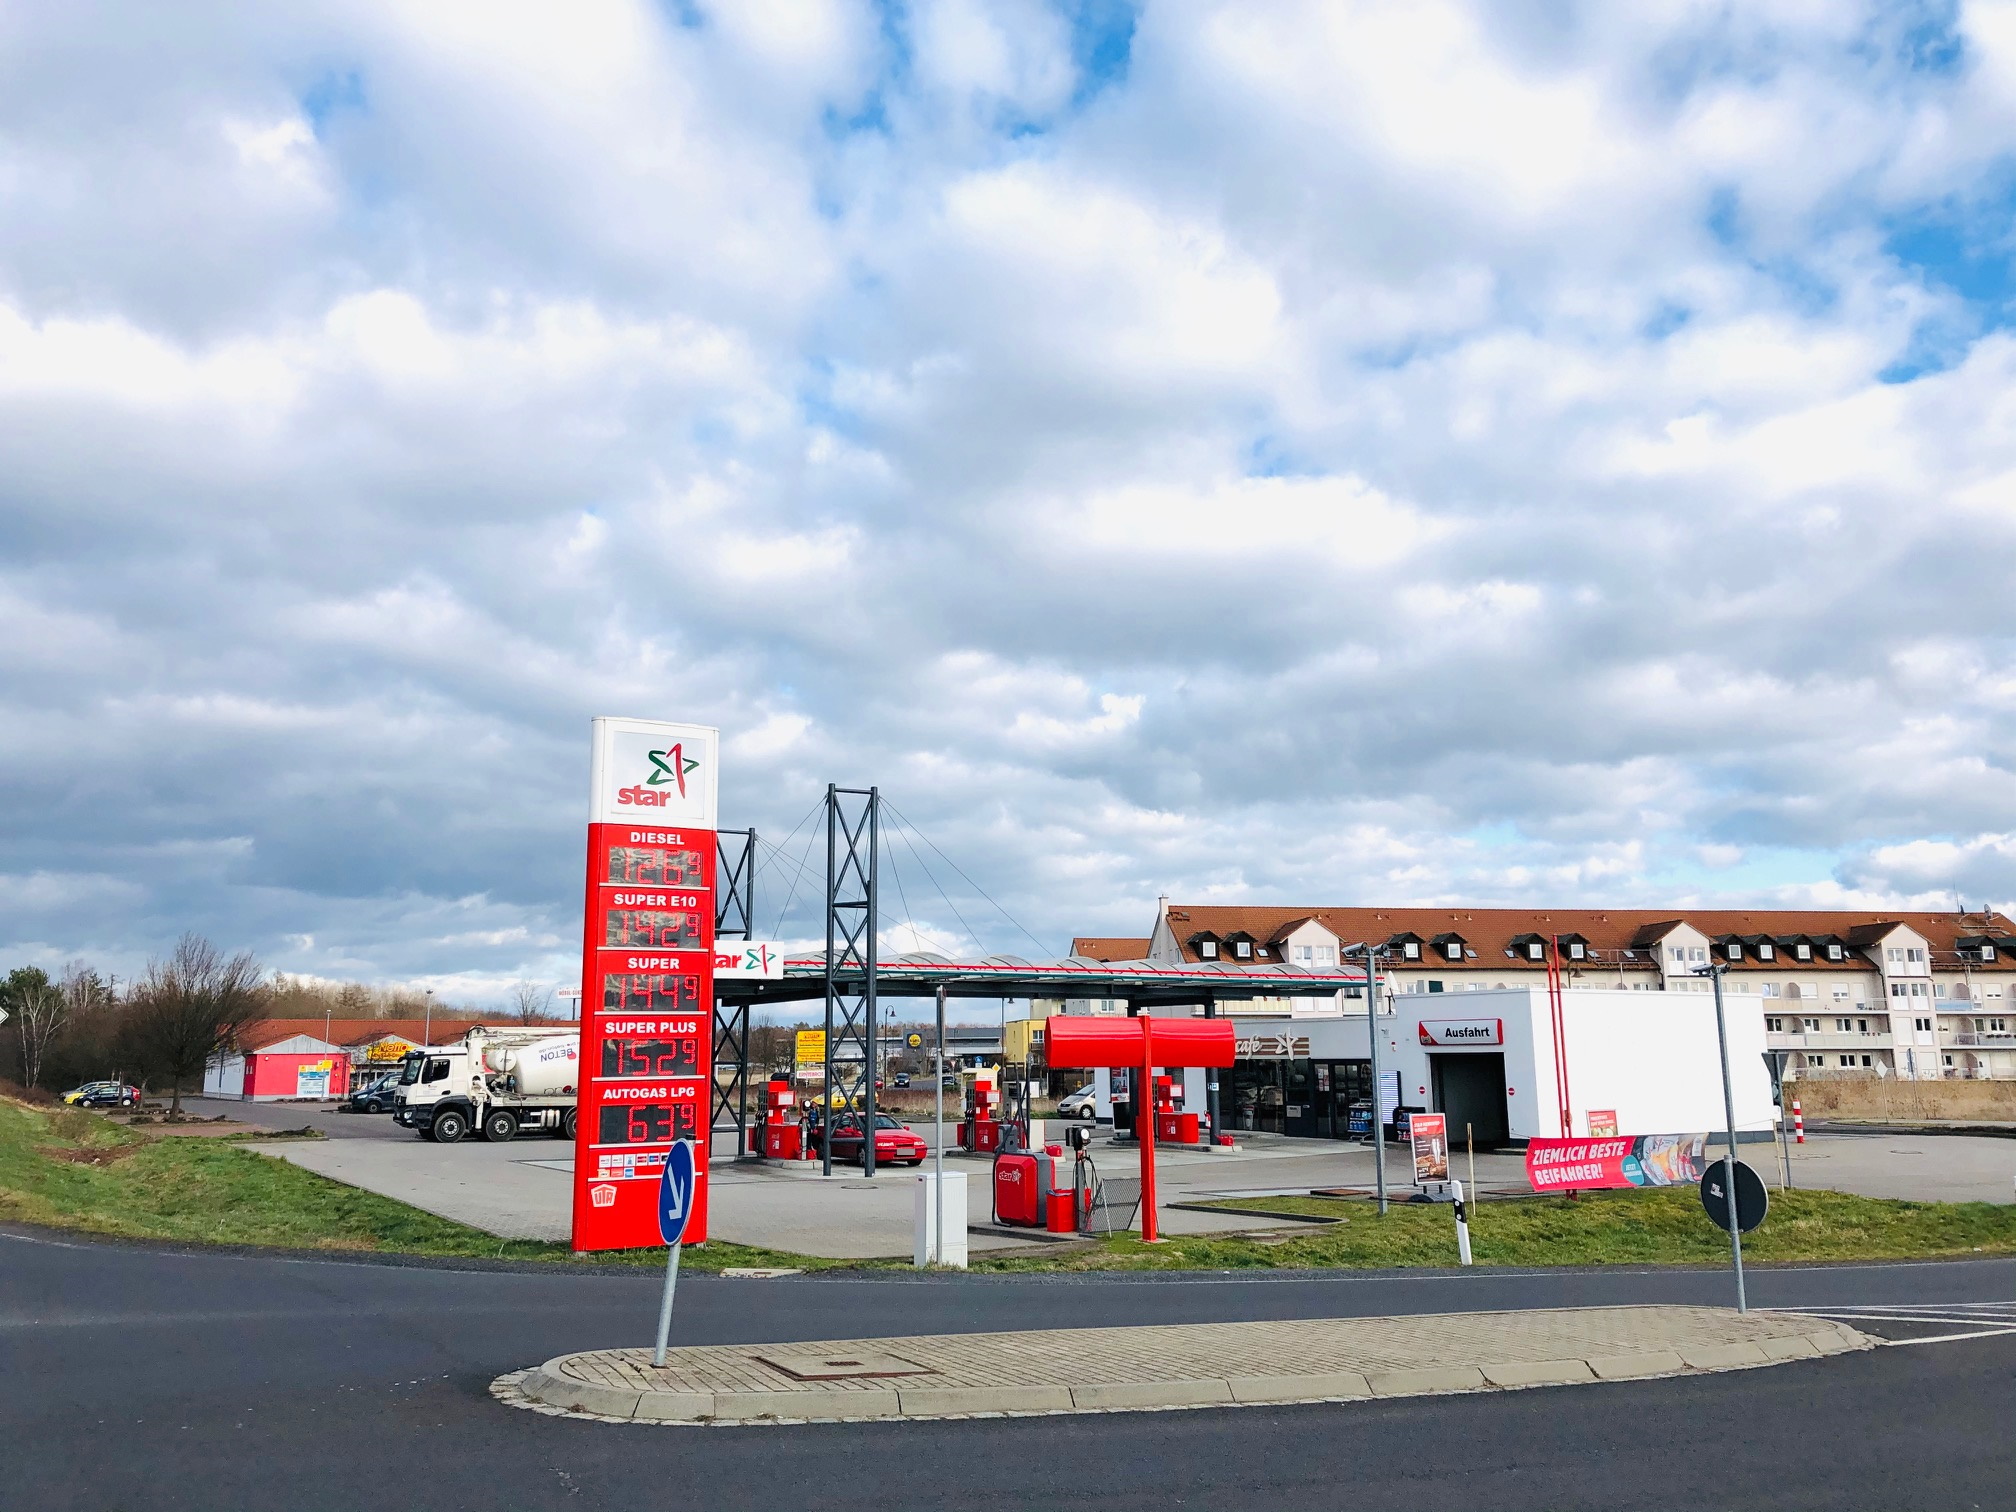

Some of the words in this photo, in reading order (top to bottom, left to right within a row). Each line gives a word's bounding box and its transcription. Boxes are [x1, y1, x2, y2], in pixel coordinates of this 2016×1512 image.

[617, 784, 671, 807] star
[630, 831, 685, 845] DIESEL
[613, 893, 667, 906] SUPER
[670, 895, 697, 907] E10
[628, 957, 680, 969] SUPER
[605, 1021, 656, 1034] SUPER
[660, 1021, 697, 1033] PLUS
[1445, 1026, 1490, 1038] Ausfahrt
[379, 1041, 408, 1052] Netto
[540, 1048, 573, 1062] BETON
[603, 1088, 667, 1099] AUTOGAS
[670, 1087, 695, 1098] LPG
[1532, 1145, 1587, 1165] ZIEMLICH
[1589, 1141, 1626, 1159] BESTE
[1535, 1162, 1603, 1185] BEIFAHRER!
[594, 1187, 614, 1205] UTA
